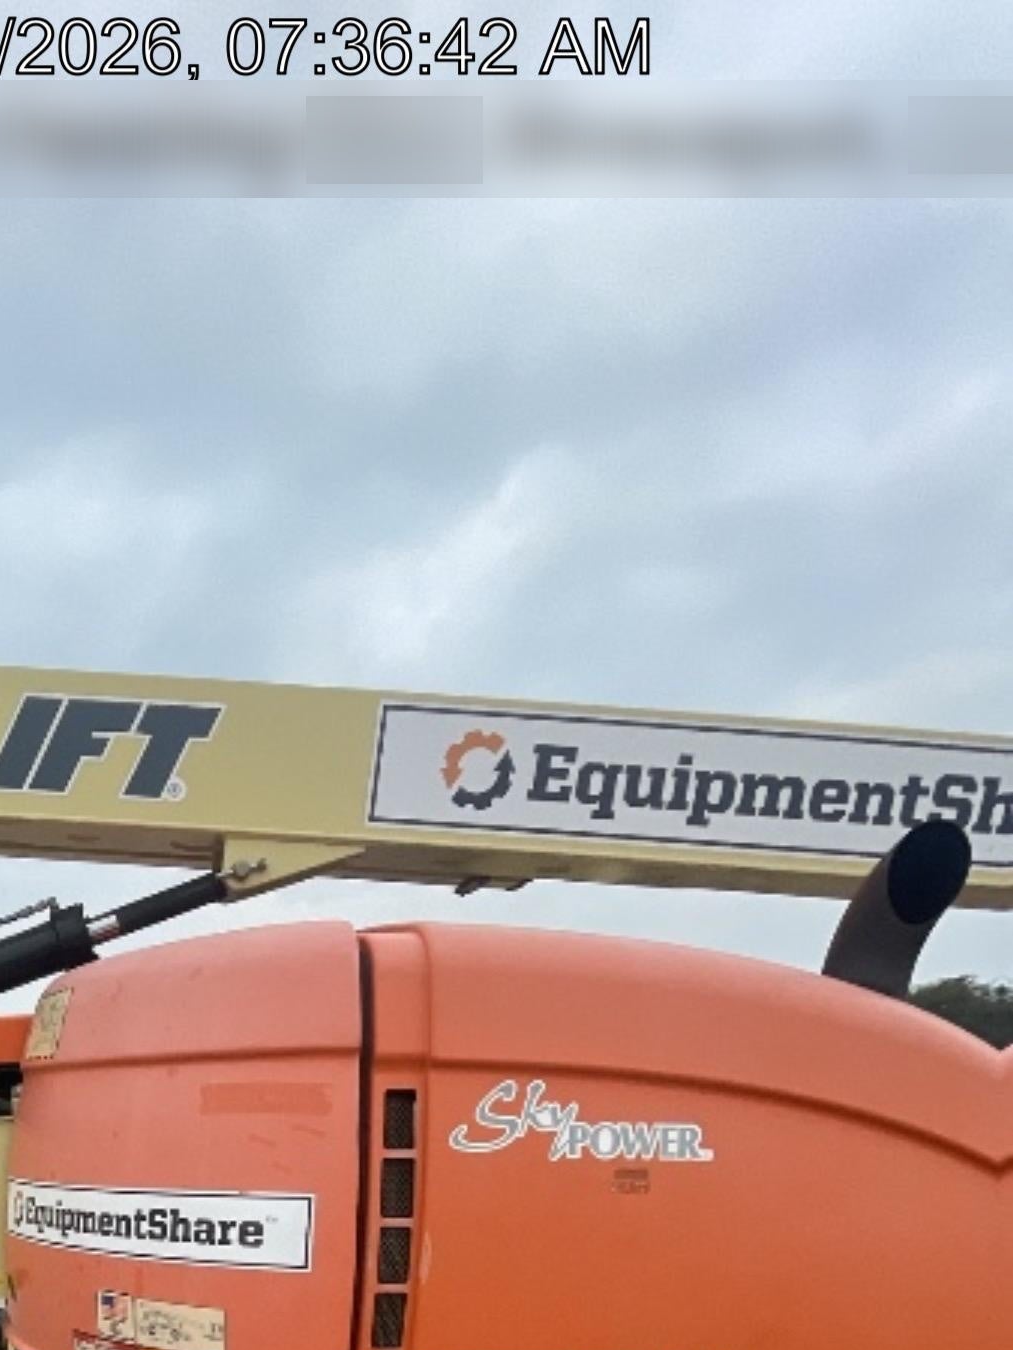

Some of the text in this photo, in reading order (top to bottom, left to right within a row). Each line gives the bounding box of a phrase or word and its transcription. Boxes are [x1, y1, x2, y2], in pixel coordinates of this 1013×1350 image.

[526, 743, 1013, 835] EquipmentSh
[449, 1080, 714, 1162] Sky POWER
[25, 1196, 265, 1249] EquipmentShare
